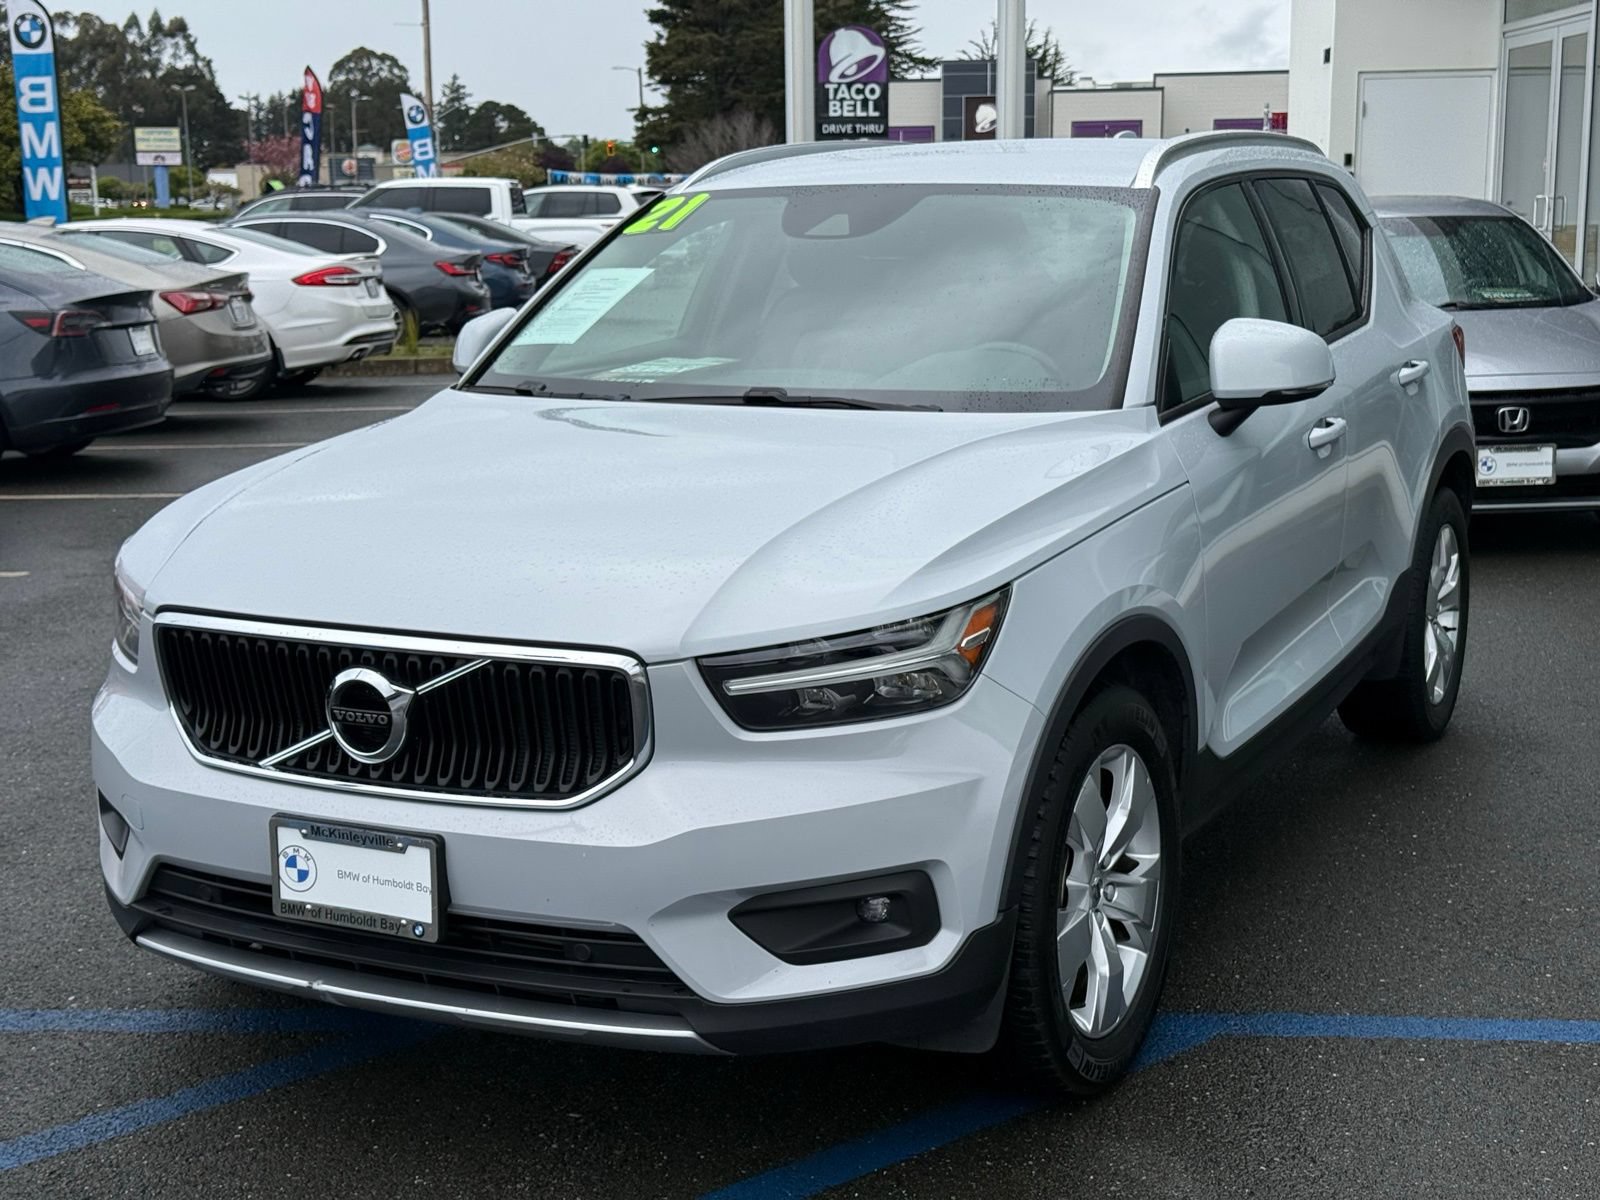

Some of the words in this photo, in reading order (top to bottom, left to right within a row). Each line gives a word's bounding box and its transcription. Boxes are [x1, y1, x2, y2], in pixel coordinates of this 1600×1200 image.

[824, 83, 881, 100] TACO
[828, 100, 880, 117] BELL
[822, 124, 853, 134] DRIVE
[855, 124, 884, 134] THRU
[622, 192, 711, 235] 21
[333, 711, 388, 725] VOLVO
[310, 825, 395, 848] McKinleyville
[282, 847, 311, 862] BMW
[337, 869, 360, 882] BMW
[361, 871, 372, 883] of
[373, 875, 414, 891] Humboldt
[280, 902, 305, 916] BMW
[311, 905, 322, 918] of
[325, 907, 377, 927] Humboldt
[380, 919, 402, 935] Bay
